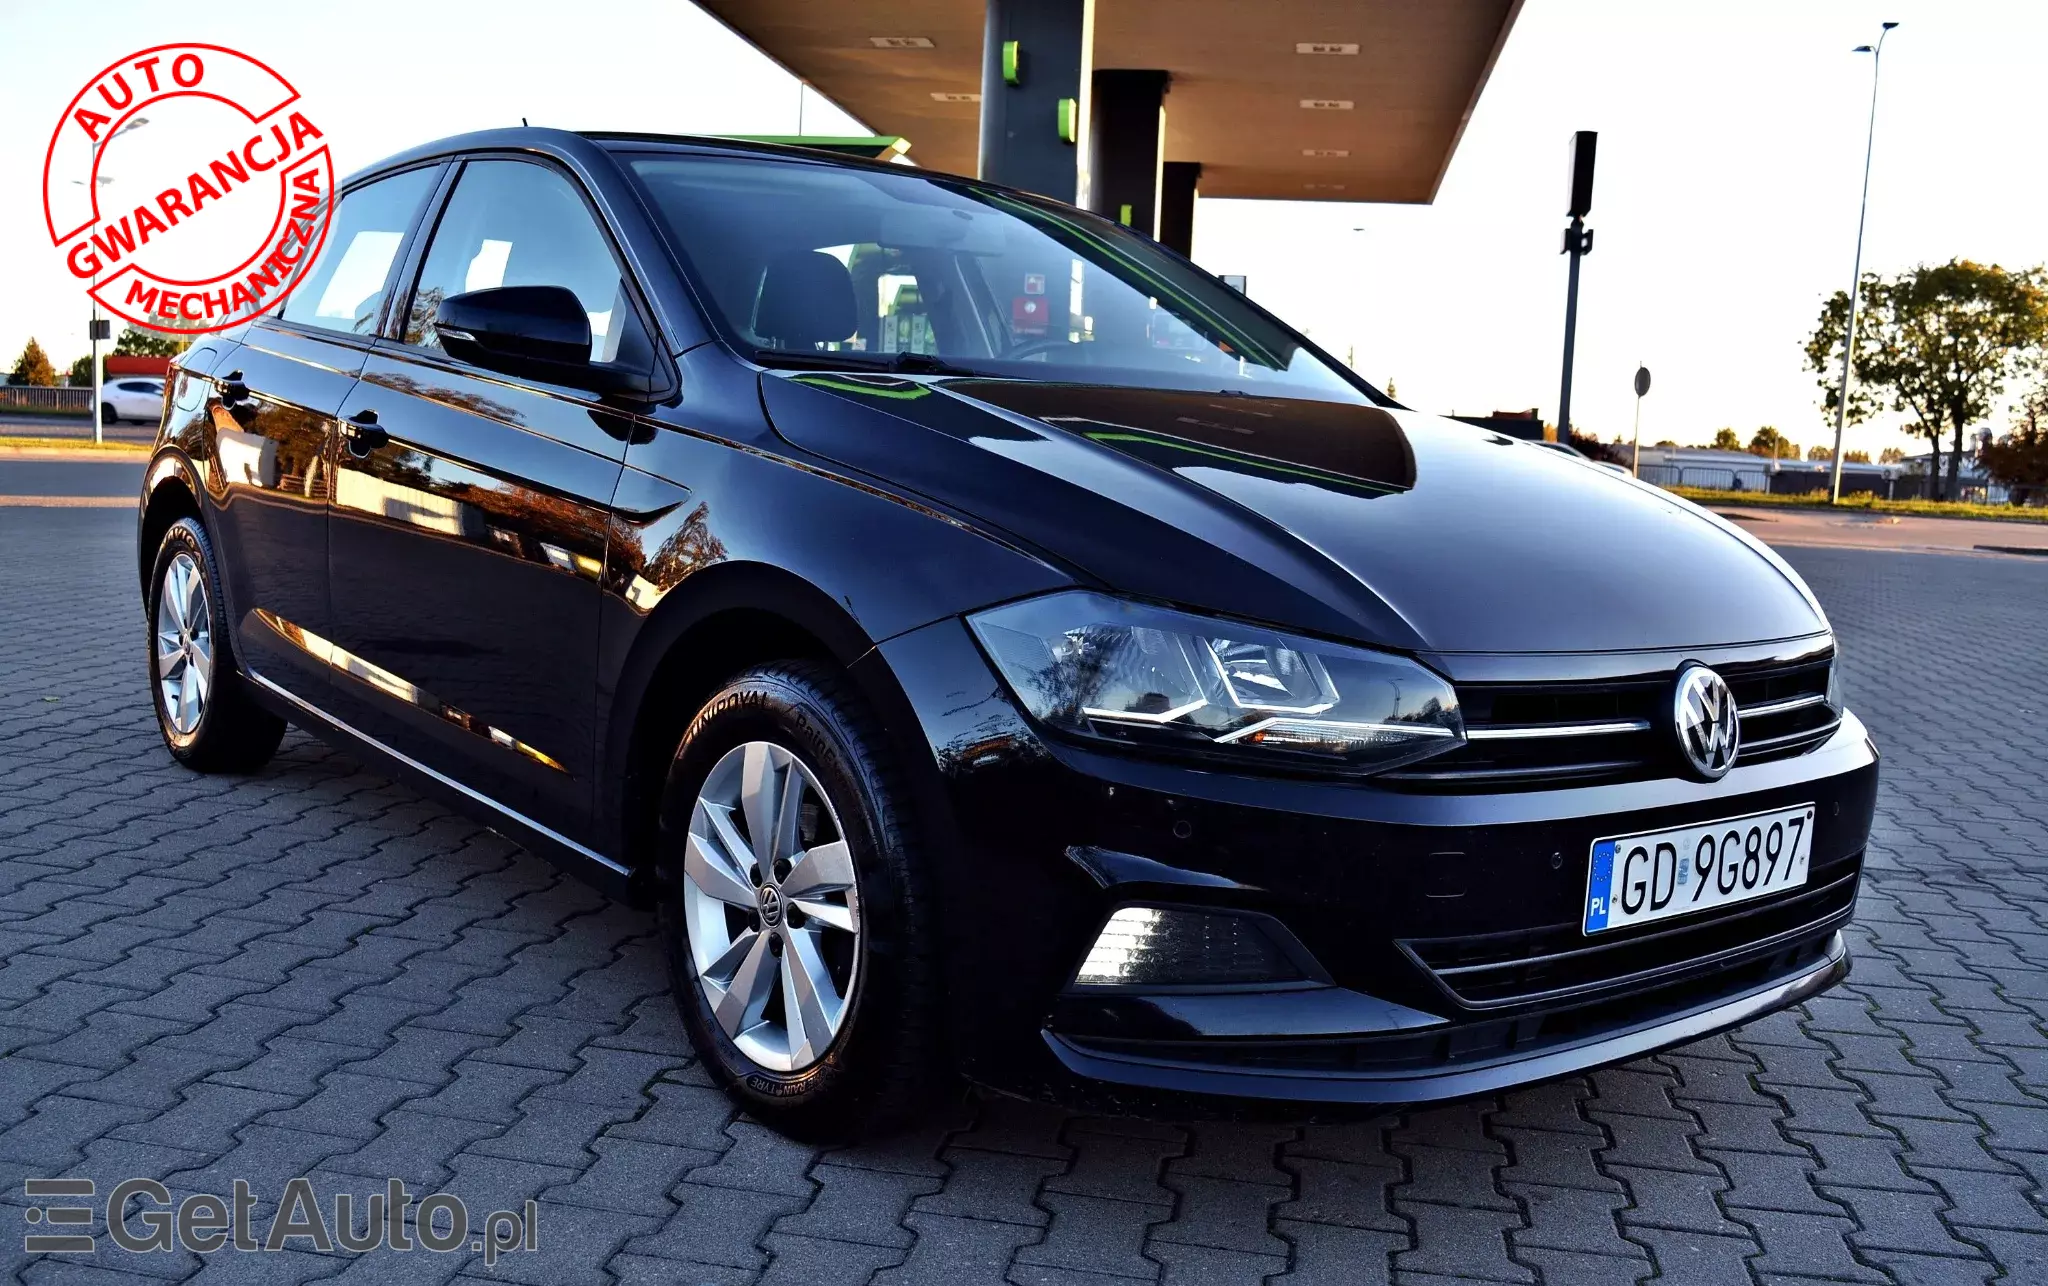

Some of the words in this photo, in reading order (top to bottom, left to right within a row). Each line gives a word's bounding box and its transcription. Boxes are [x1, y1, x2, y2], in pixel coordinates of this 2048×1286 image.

[689, 690, 767, 741] UNIROYAL
[1621, 841, 1677, 915] GD
[1692, 815, 1805, 902] 9G897
[1590, 897, 1607, 917] PL
[750, 1077, 776, 1094] TYRE
